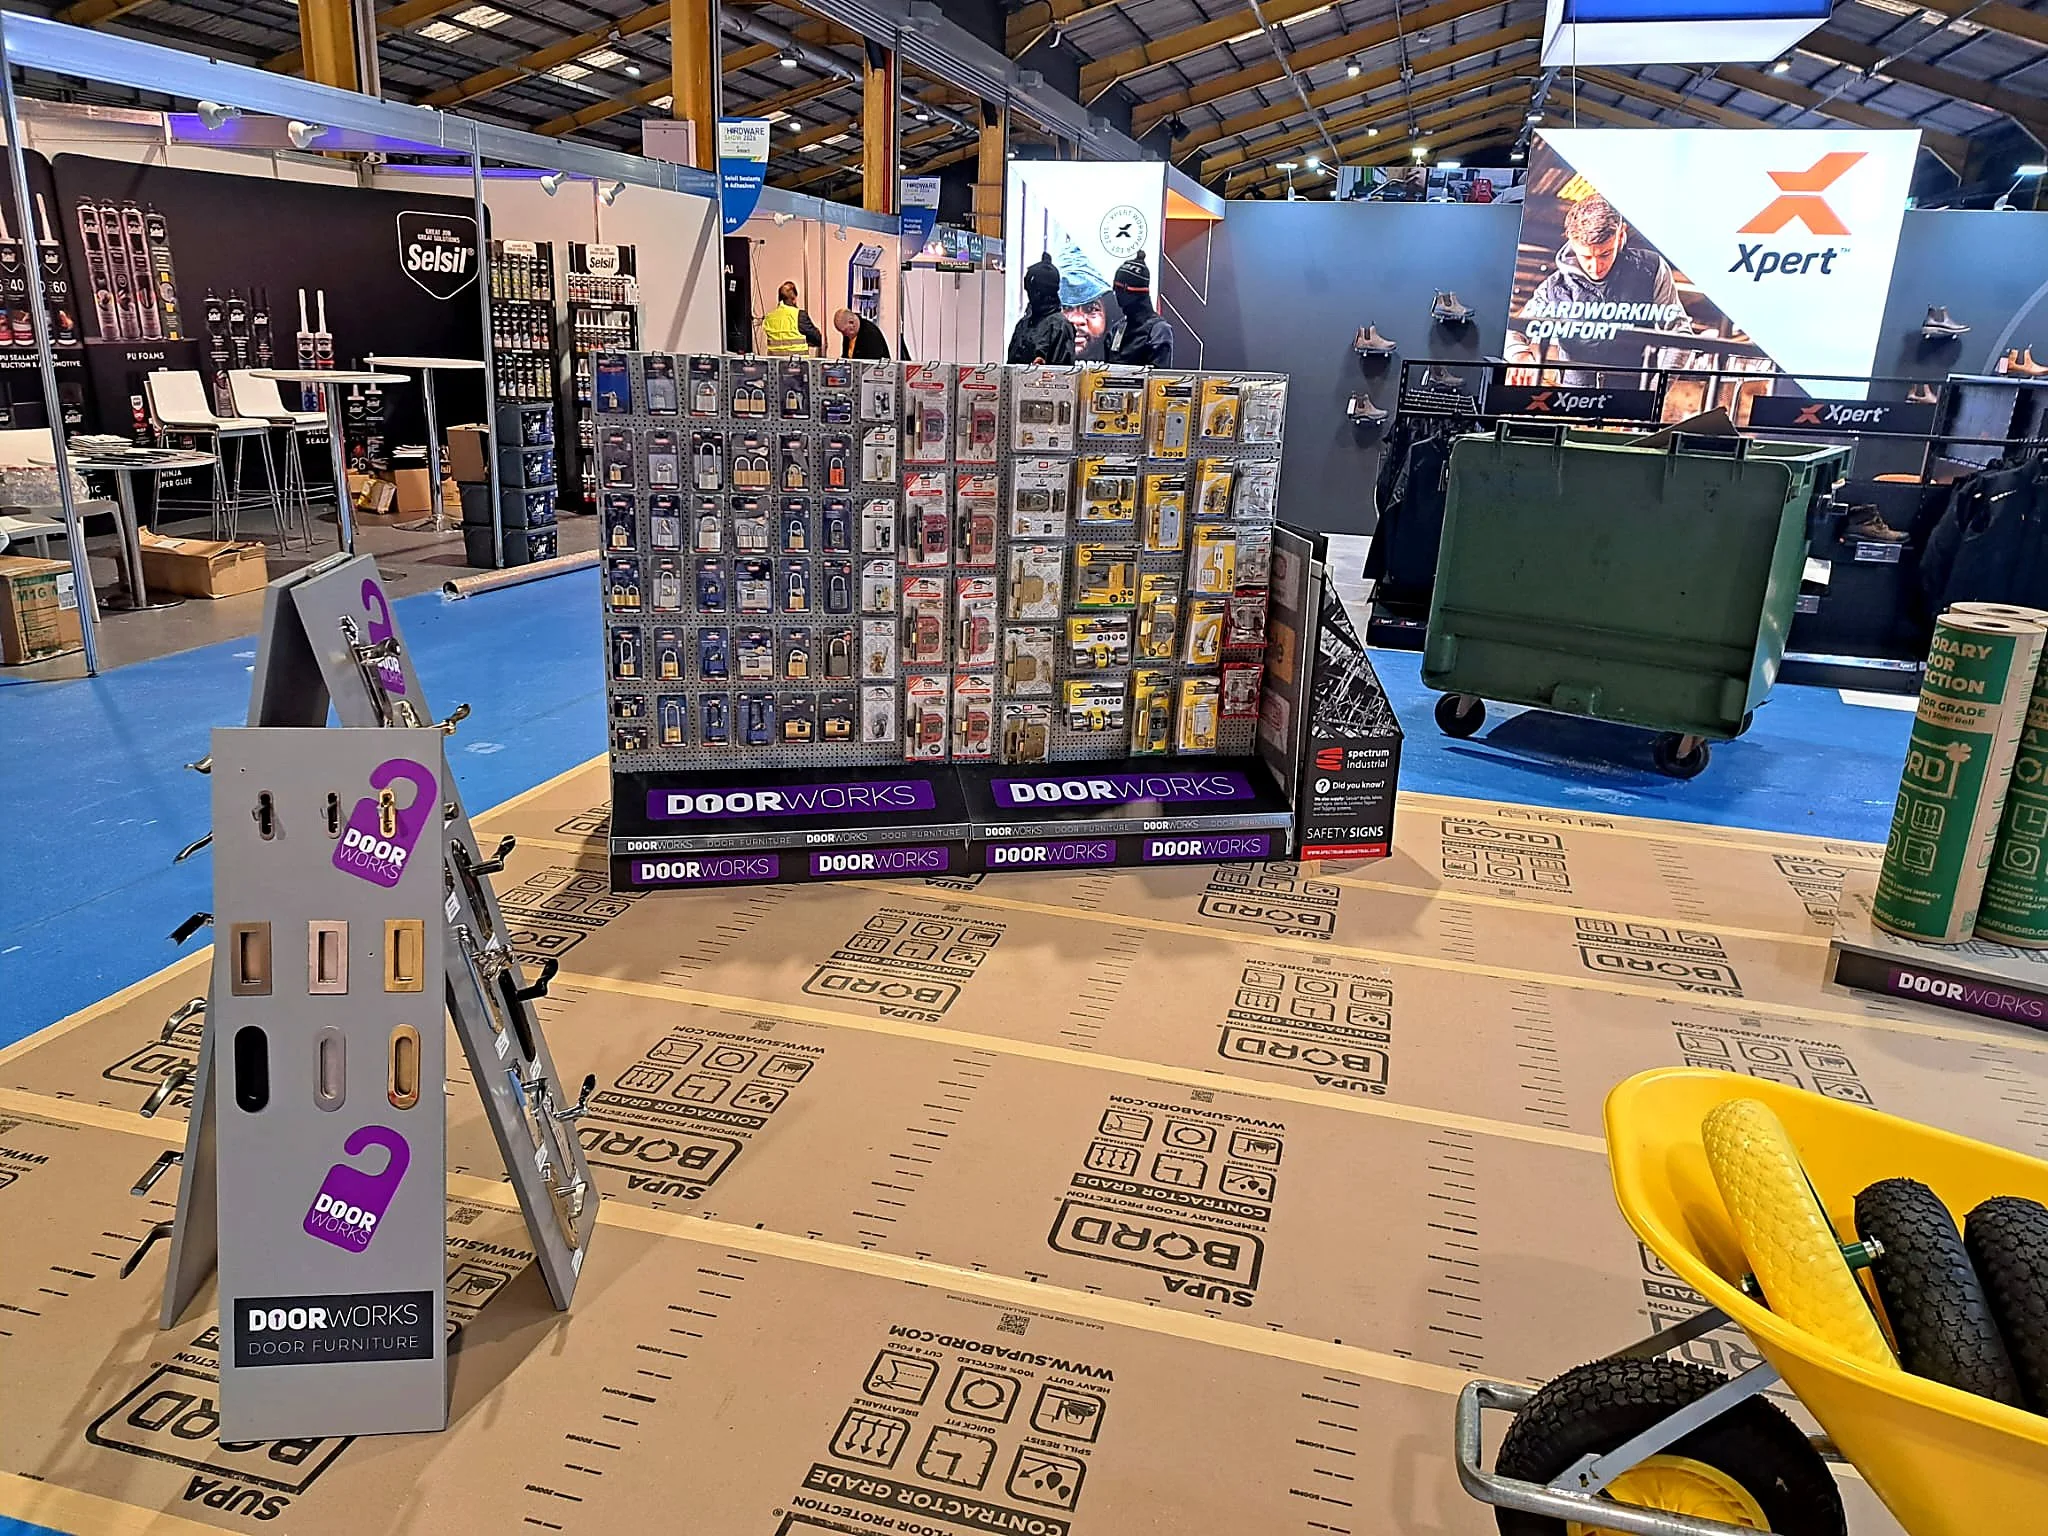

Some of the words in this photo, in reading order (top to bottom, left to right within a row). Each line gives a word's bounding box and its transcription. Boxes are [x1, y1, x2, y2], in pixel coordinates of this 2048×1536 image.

[1526, 302, 1681, 323] HARDWORKING
[138, 352, 164, 360] FOAMS
[161, 470, 182, 478] NINJA
[175, 478, 192, 486] GLUE
[1938, 702, 1986, 718] GRADE
[1347, 760, 1388, 769] industrial
[1348, 750, 1390, 760] spectrum
[1010, 776, 1234, 802] DOORWORKS
[1332, 781, 1345, 789] Did
[1346, 782, 1360, 790] you
[1361, 780, 1385, 789] know?
[667, 785, 916, 815] DOORWORKS
[707, 839, 734, 848] DOOR
[740, 837, 792, 847] FURNITURE
[1306, 827, 1348, 839] SAFETY
[1349, 826, 1384, 838] SIGNS
[343, 828, 407, 868] DOOR
[994, 843, 1107, 863] DOORWORKS
[1151, 837, 1261, 856] DOORWORKS
[340, 847, 400, 880] WORKS
[641, 858, 769, 880] DOORWORKS
[819, 850, 939, 872] DOORWORKS
[924, 879, 976, 892] SUPA
[1213, 901, 1321, 926] BORD
[1273, 926, 1331, 940] SUPA
[1596, 954, 1722, 981] BORD
[820, 974, 944, 1004] BORD
[1898, 972, 2043, 1018] DOORWORKS
[879, 1006, 941, 1023] SUPA
[672, 1024, 825, 1054] WWW.SUPABORD.COM
[1236, 1037, 1371, 1072] BORD
[1313, 1074, 1387, 1095] SUPA
[599, 1093, 652, 1108] GRADE
[650, 1114, 687, 1127] FLOOR
[654, 1103, 763, 1127] CONTRACTOR
[1109, 1095, 1285, 1130] WWW.SUPABORD.COM
[687, 1121, 753, 1139] TEMPORARY
[628, 1174, 707, 1201] SUPA
[1076, 1176, 1137, 1192] GRADE
[1066, 1190, 1143, 1208] PROTECTION
[1142, 1187, 1266, 1217] CONTRACTOR
[314, 1193, 377, 1232] DOOR
[1145, 1203, 1189, 1217] FLOOR
[310, 1210, 370, 1246] WORKS
[1190, 1210, 1268, 1233] TEMPORARY
[1071, 1216, 1240, 1271] BORD
[1162, 1275, 1255, 1308] SUPA
[248, 1304, 419, 1332] DOORWORKS
[249, 1341, 304, 1356] DOOR
[312, 1335, 419, 1352] FURNITURE
[887, 1324, 1114, 1382] WWW.SUPABORD.COM
[888, 1342, 914, 1351] FOLD
[923, 1349, 943, 1358] CUT
[957, 1356, 1009, 1372] RECYCLED
[1010, 1368, 1035, 1378] 100%
[1047, 1376, 1075, 1386] DUTY
[1076, 1380, 1110, 1394] HEAVY
[853, 1398, 920, 1417] BREATHABLE
[944, 1418, 961, 1427] FIT
[962, 1423, 996, 1434] QUICK
[1024, 1435, 1062, 1450] RESIST
[1064, 1444, 1091, 1456] SPILL
[810, 1468, 892, 1498] GRADE
[182, 1474, 292, 1522] SUPA
[791, 1494, 896, 1529] PROTECTION
[897, 1490, 1063, 1536] CONTRACTOR
